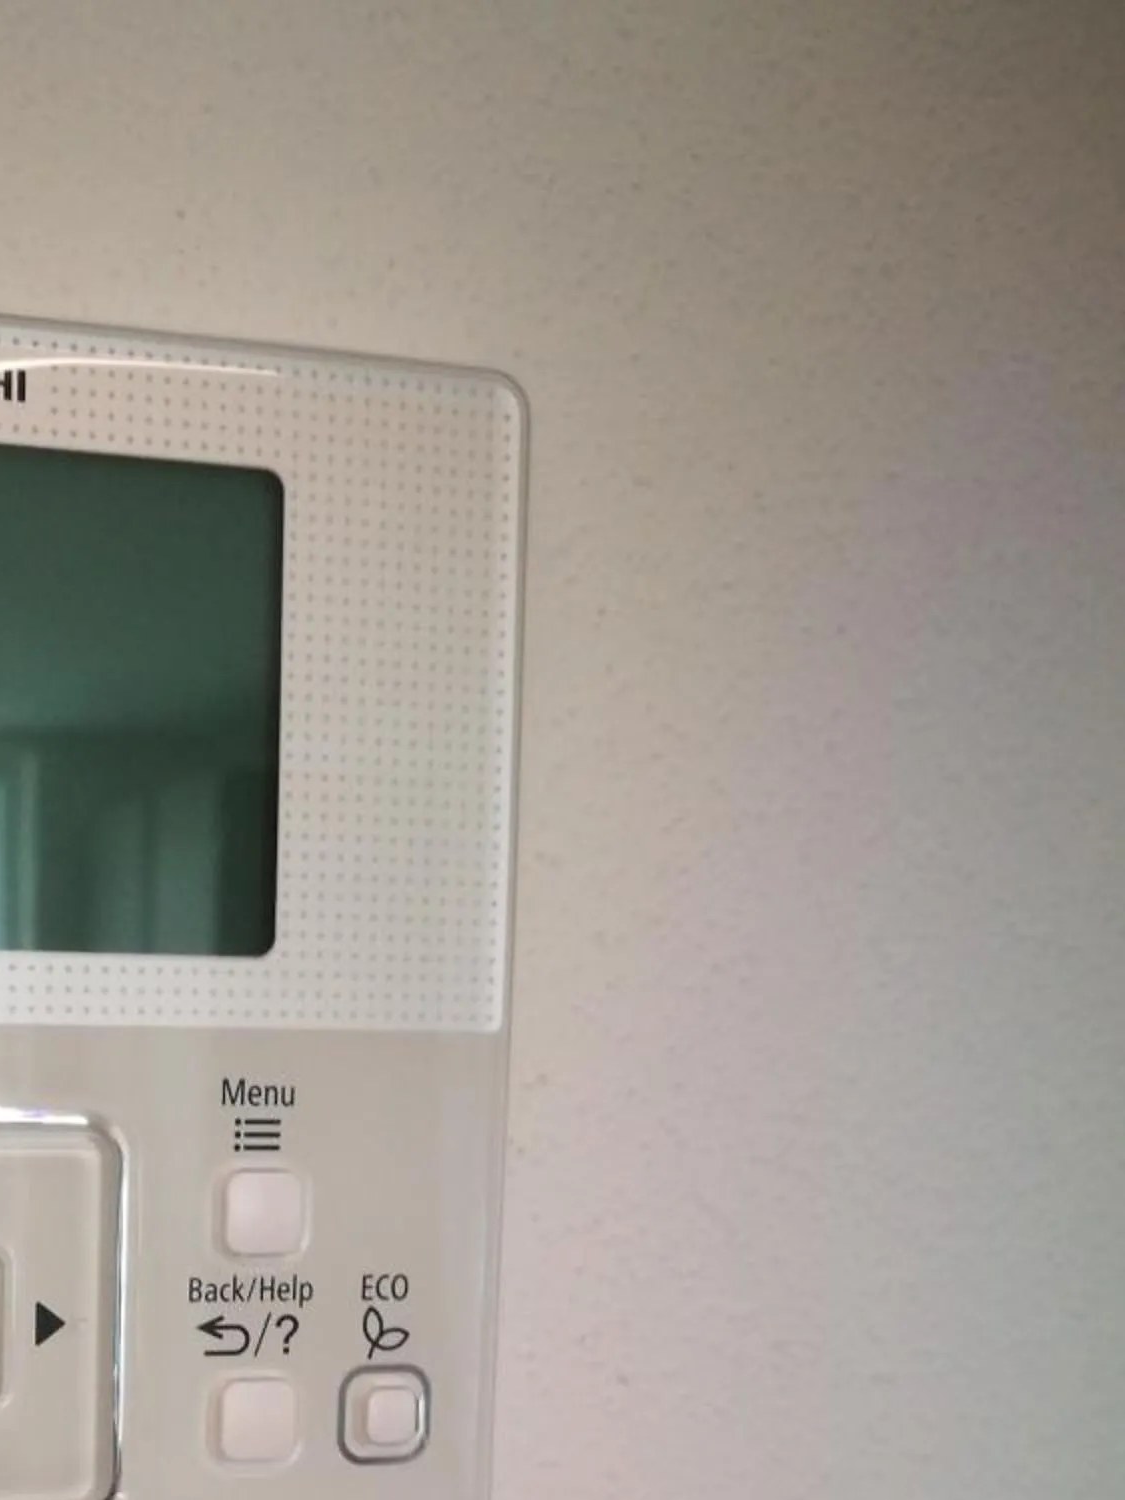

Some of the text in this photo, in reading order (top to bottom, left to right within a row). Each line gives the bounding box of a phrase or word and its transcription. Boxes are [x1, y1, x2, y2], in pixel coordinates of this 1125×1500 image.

[221, 1078, 296, 1107] Menu
[188, 1275, 314, 1307] Back/Help
[361, 1274, 409, 1301] ECO
